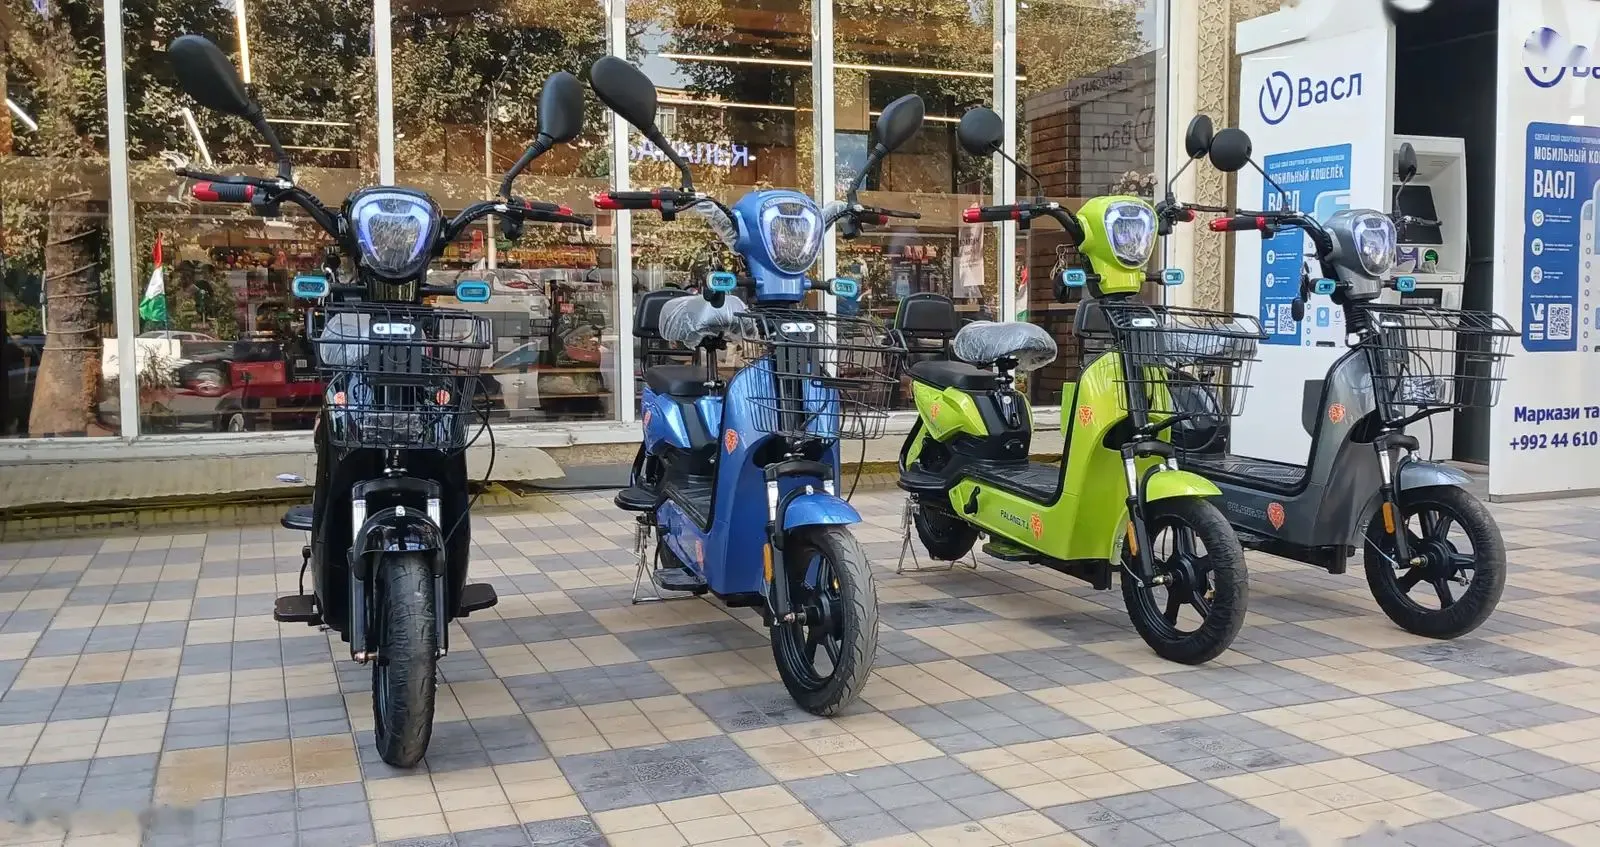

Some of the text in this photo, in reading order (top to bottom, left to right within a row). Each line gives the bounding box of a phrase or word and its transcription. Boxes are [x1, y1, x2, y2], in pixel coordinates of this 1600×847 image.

[1298, 73, 1362, 107] Васл
[1534, 146, 1600, 164] МОБИЛЬНЫЙ КО
[1269, 164, 1344, 185] МОБИЛЬНЫЙ КОШЕЛЁК
[1533, 169, 1575, 199] ВАСЛ
[1514, 406, 1580, 425] Маркази
[1509, 431, 1598, 451] +992 44 610
